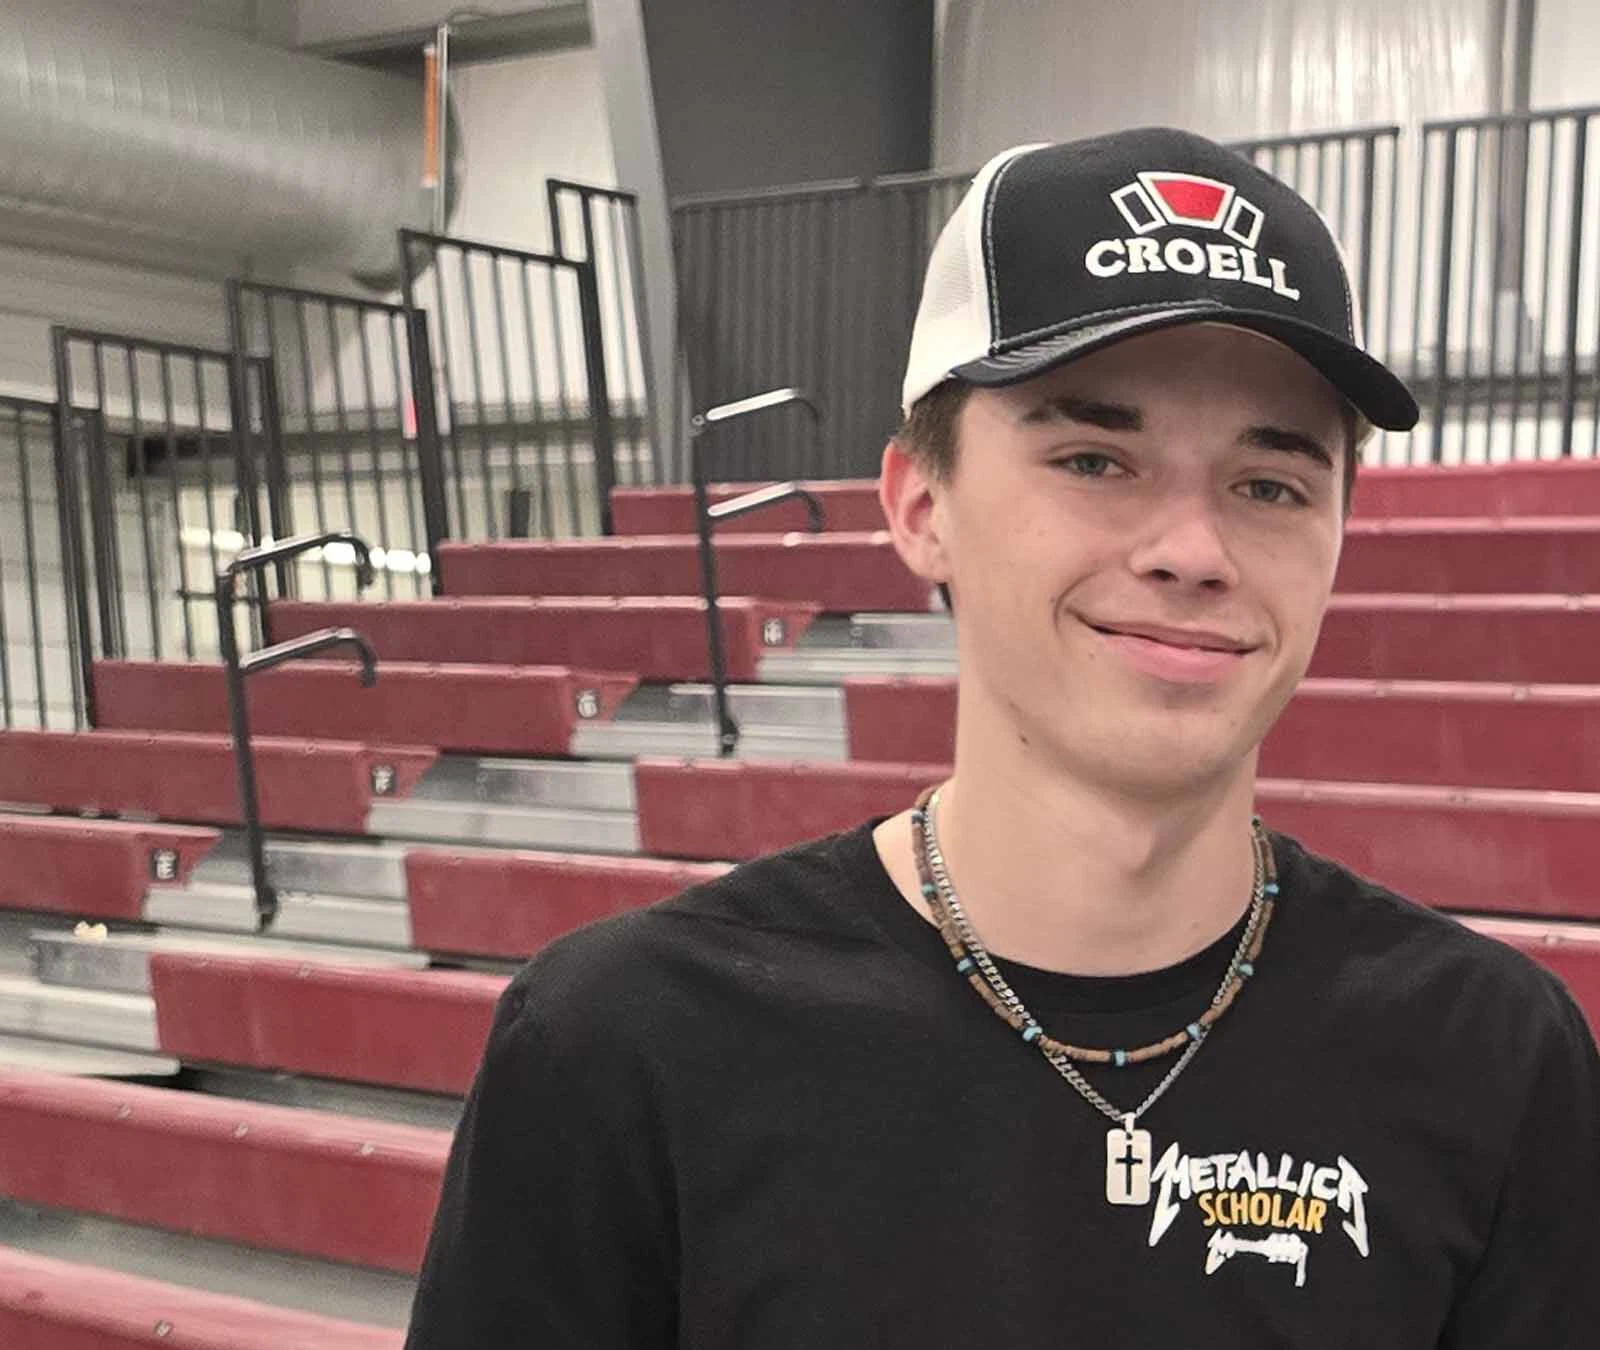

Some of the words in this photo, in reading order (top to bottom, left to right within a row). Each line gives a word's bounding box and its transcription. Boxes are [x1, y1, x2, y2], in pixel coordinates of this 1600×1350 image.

[1084, 237, 1301, 302] CROELL
[1148, 1141, 1370, 1258] METALLICA
[1199, 1191, 1328, 1235] SCHOLAR
